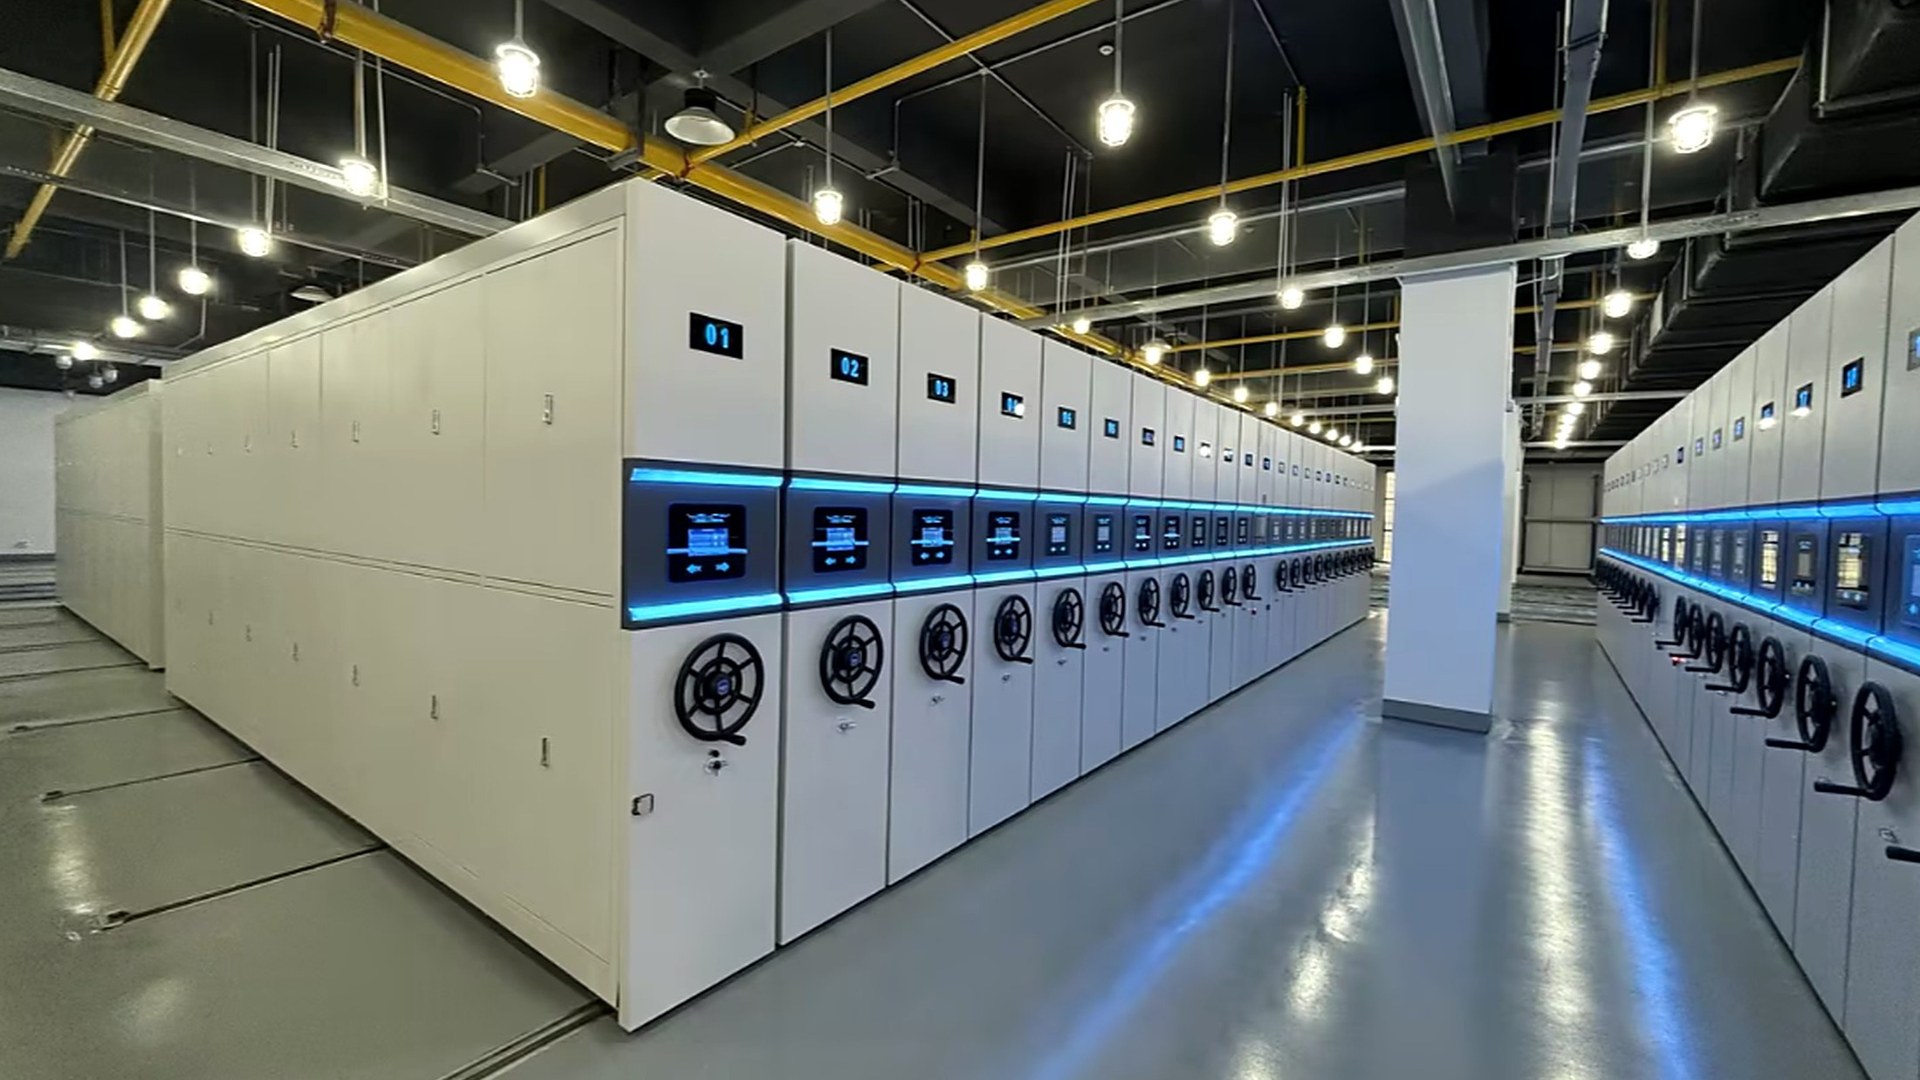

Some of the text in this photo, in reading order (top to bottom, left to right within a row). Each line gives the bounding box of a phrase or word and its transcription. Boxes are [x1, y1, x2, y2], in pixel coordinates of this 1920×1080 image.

[705, 323, 729, 349] 01
[841, 357, 859, 378] 02
[935, 379, 949, 397] 03
